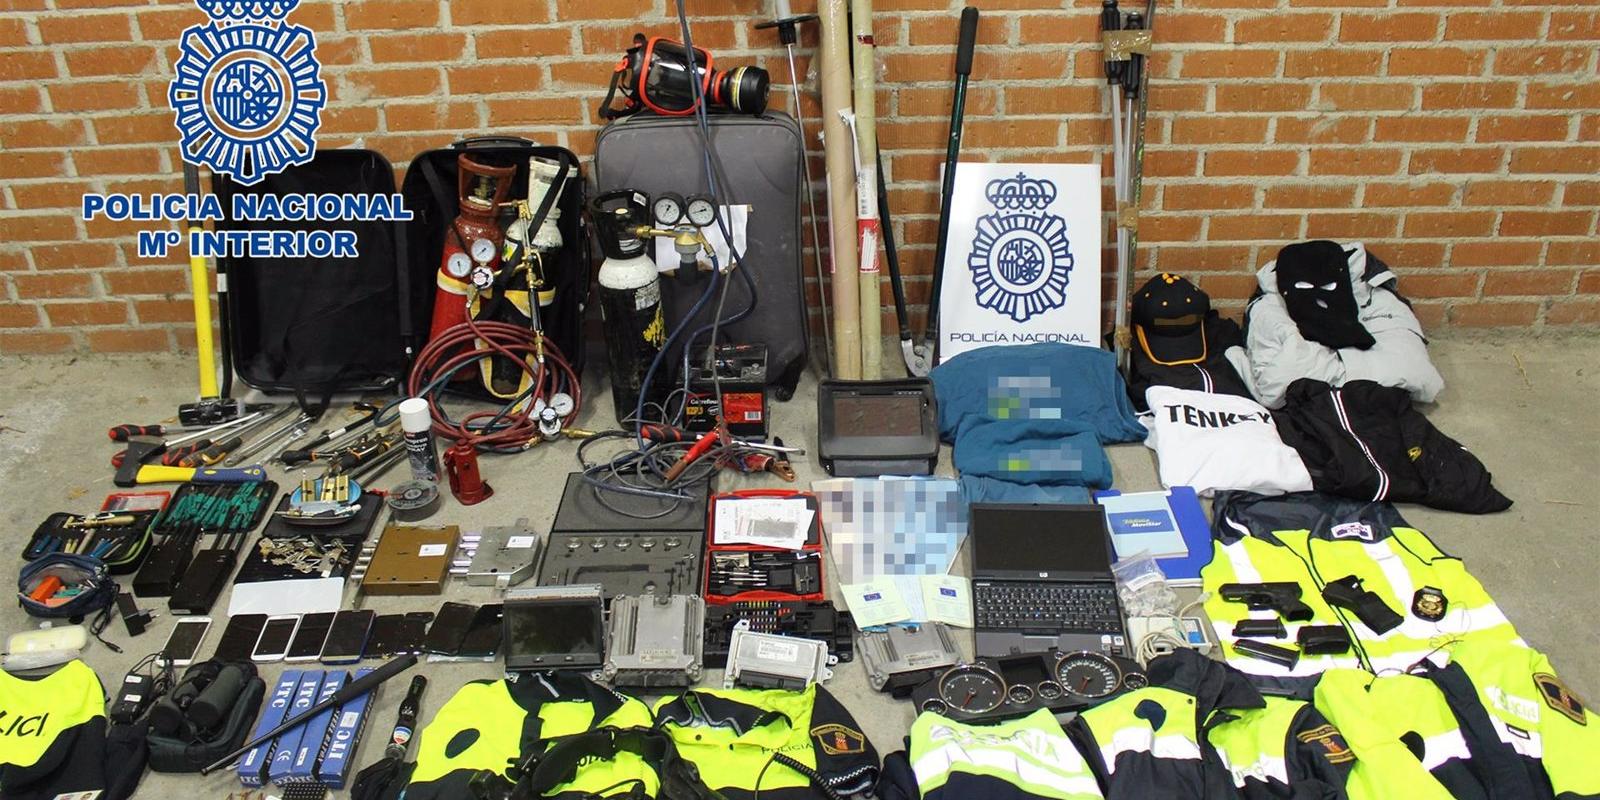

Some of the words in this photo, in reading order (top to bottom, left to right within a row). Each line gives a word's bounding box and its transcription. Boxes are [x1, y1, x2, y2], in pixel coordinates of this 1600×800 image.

[950, 331, 1009, 343] POLICÍA
[1013, 333, 1090, 343] NACIONAL
[272, 681, 295, 708] ITC
[296, 681, 317, 708] ITC
[328, 730, 351, 759] ITC
